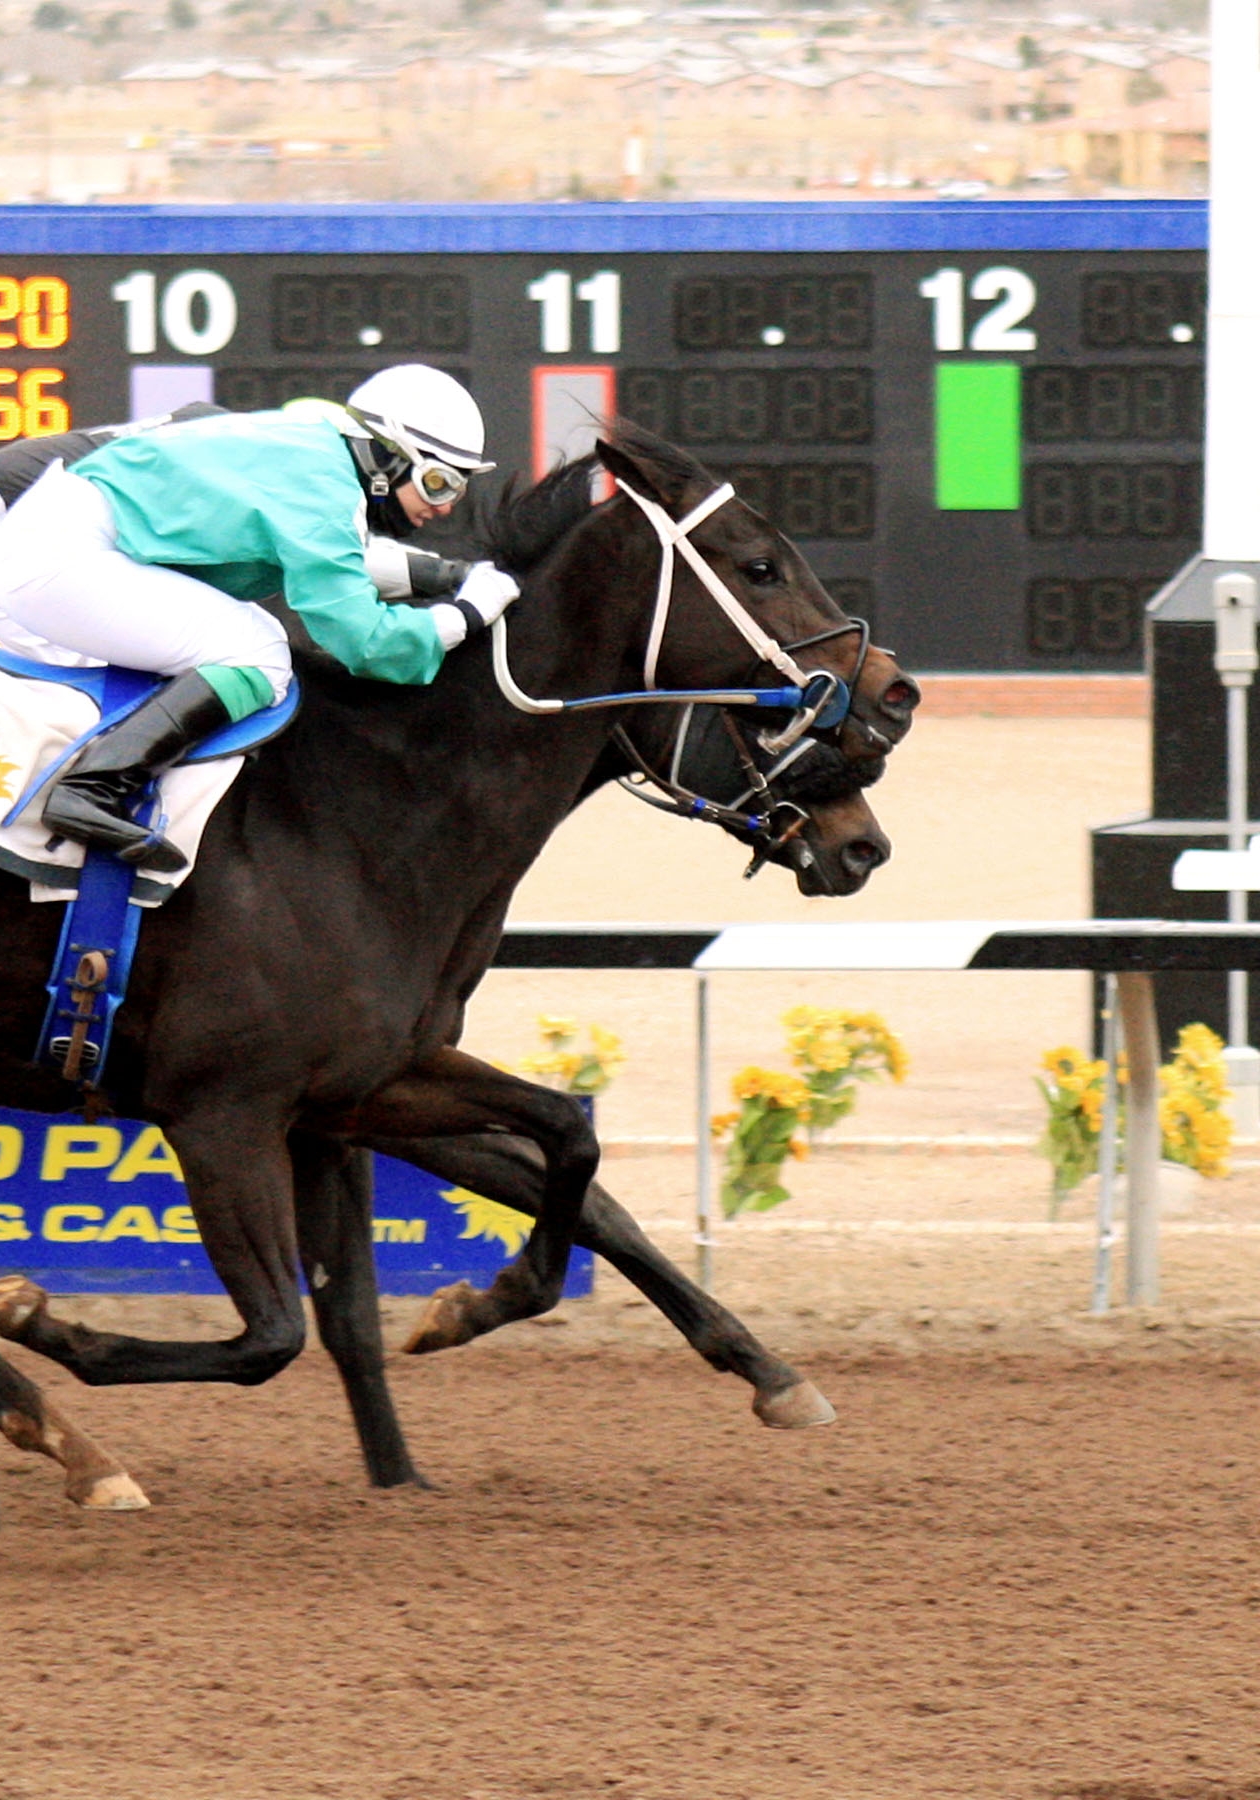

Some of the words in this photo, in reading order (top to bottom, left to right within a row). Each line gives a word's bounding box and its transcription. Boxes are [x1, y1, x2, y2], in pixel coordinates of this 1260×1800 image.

[112, 269, 238, 355] 10
[527, 269, 621, 353] 11
[919, 267, 1037, 351] 12
[40, 1124, 186, 1183] PA
[42, 1204, 203, 1244] CAS
